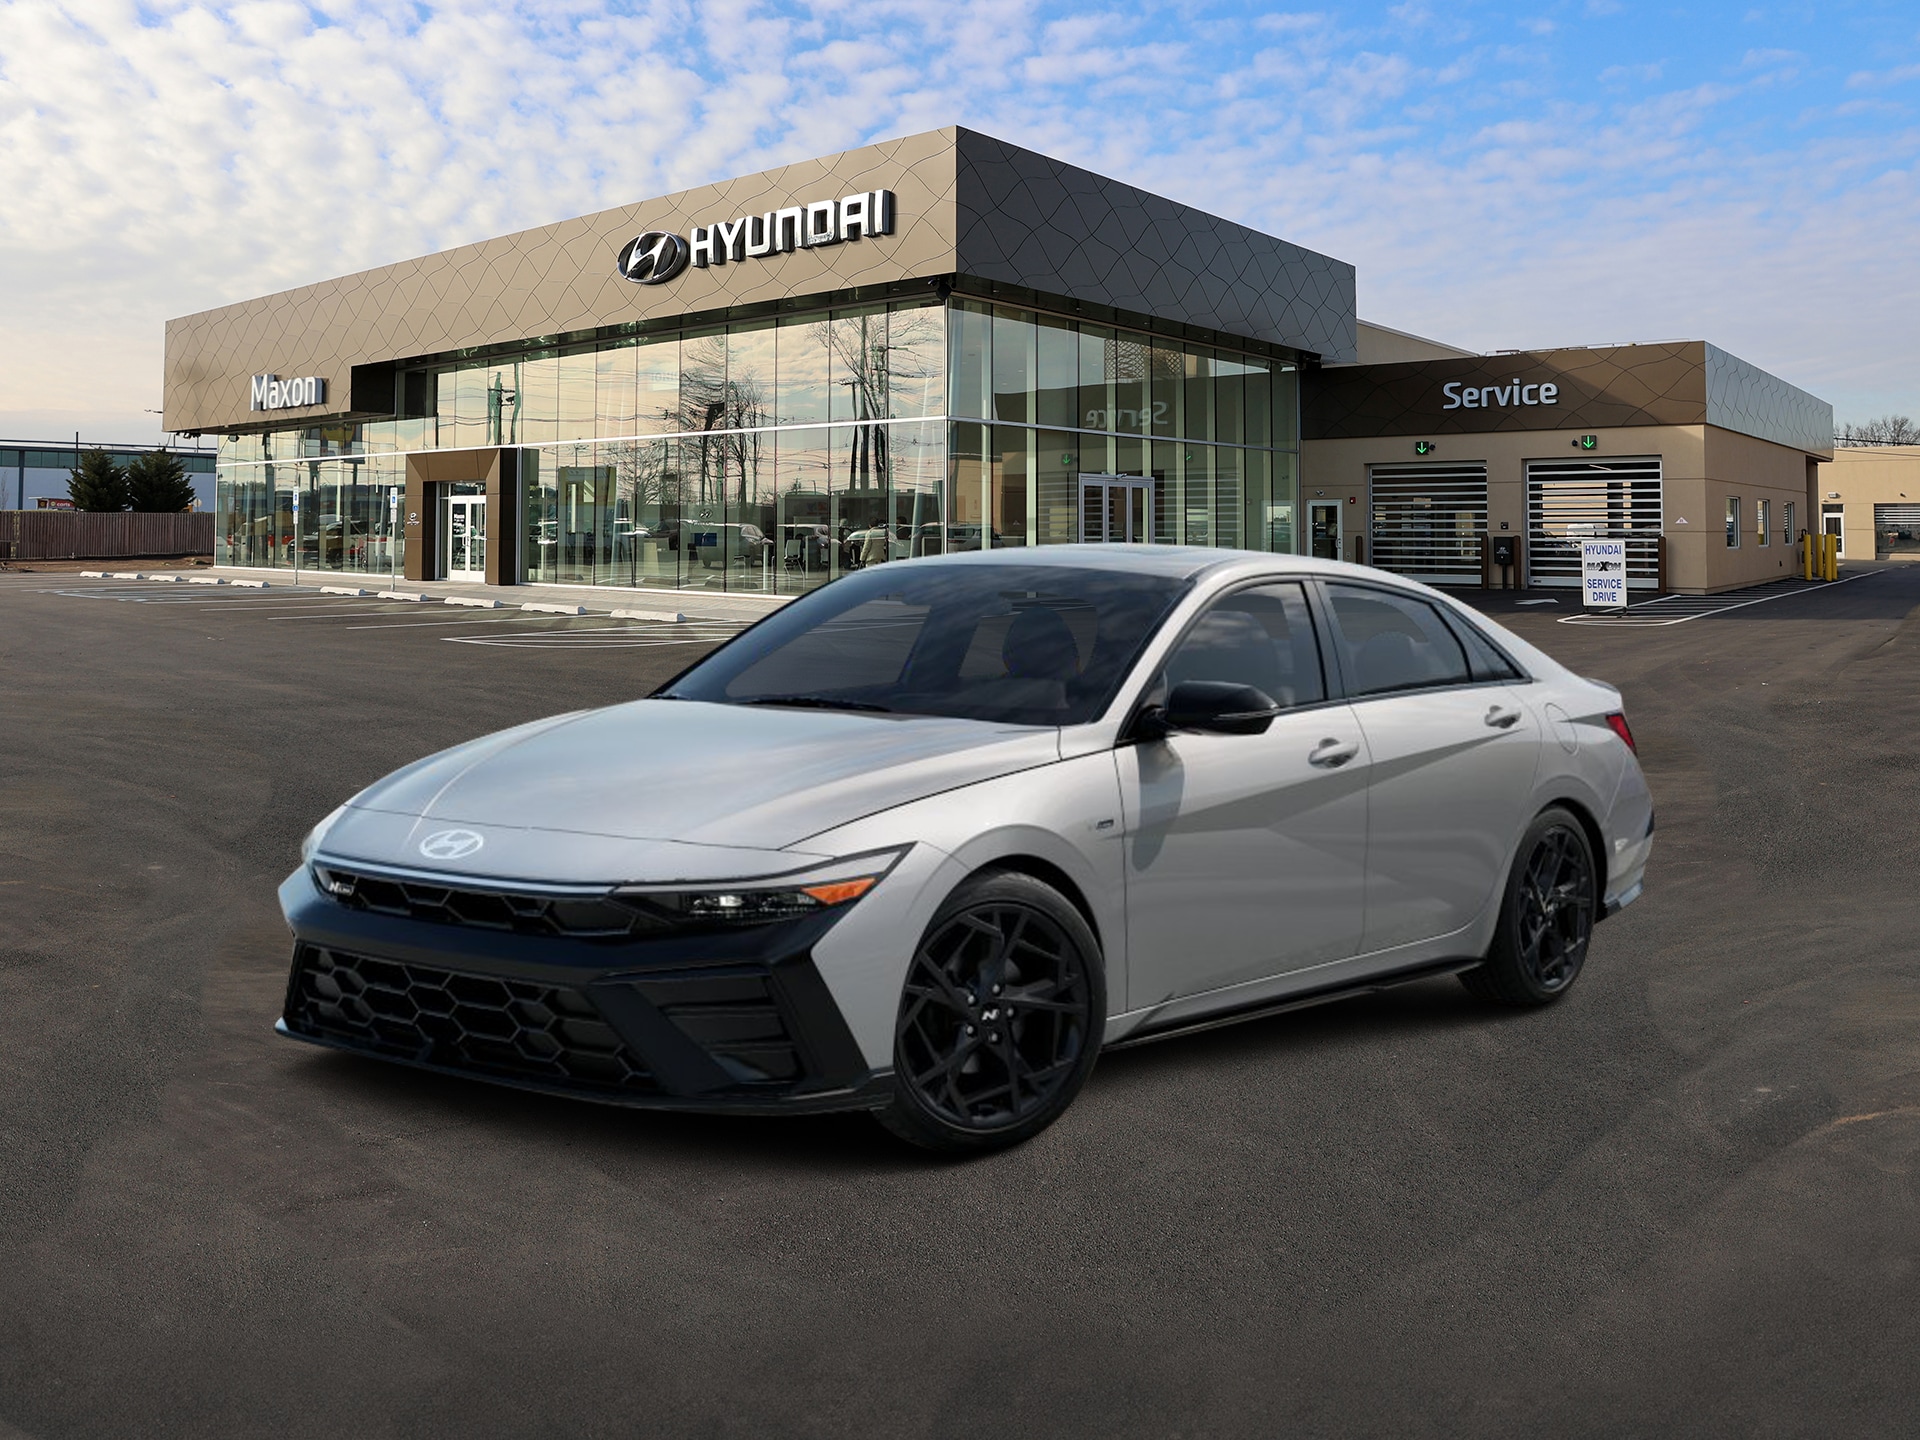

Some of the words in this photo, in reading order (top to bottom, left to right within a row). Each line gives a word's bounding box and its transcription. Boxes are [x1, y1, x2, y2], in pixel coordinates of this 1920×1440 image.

[690, 189, 890, 267] HYUNDAI
[250, 373, 320, 411] Maxon
[1442, 378, 1559, 411] Service
[1585, 544, 1622, 555] HYUNDAI
[1586, 561, 1622, 571] MAXON
[1587, 578, 1622, 589] SERVICE
[1593, 592, 1617, 602] DRIVE
